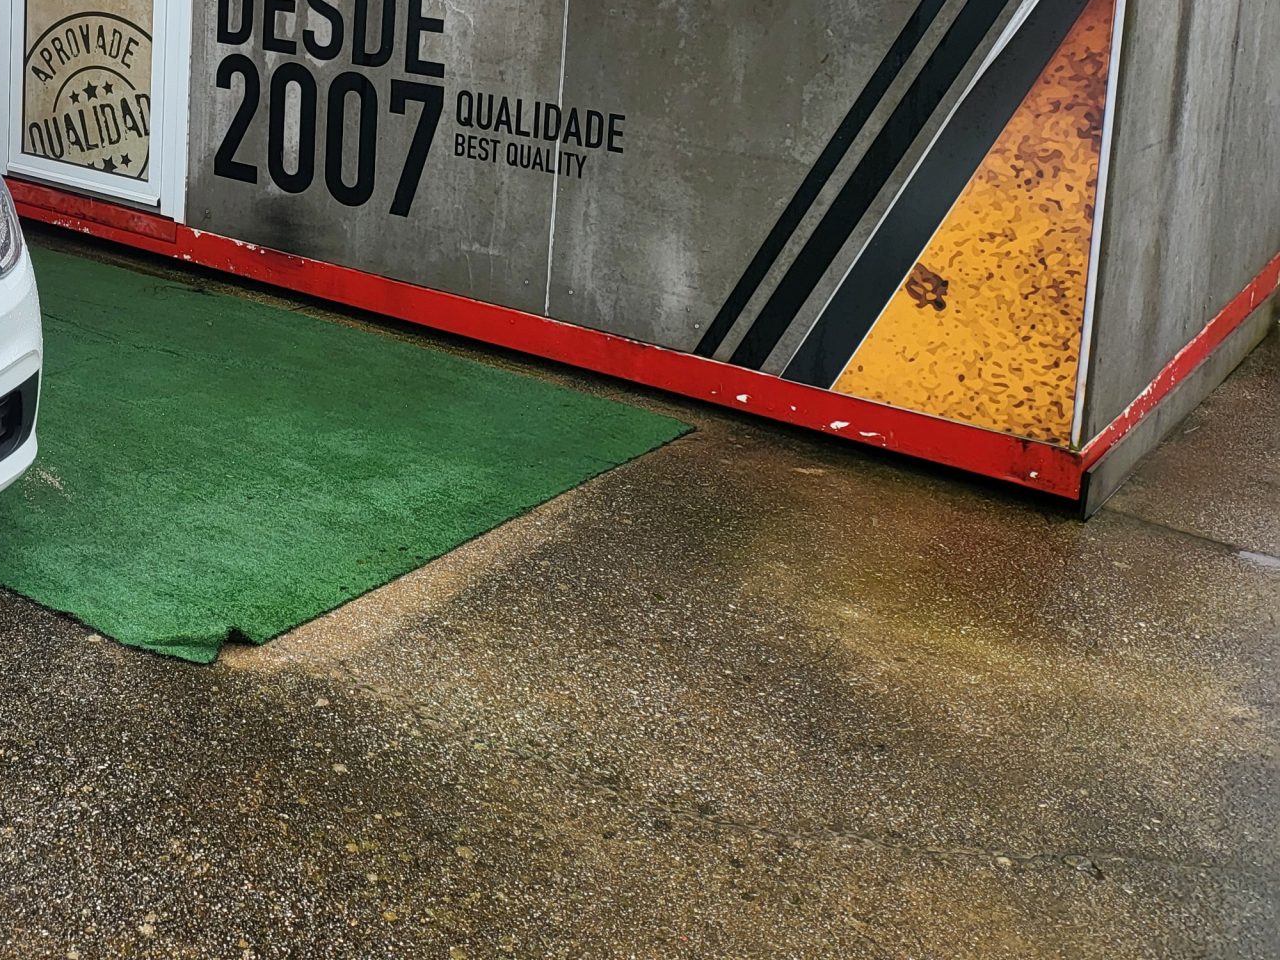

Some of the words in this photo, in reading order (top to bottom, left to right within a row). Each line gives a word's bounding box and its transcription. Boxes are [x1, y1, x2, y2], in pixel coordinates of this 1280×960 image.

[31, 24, 140, 83] APROVADE
[214, 53, 444, 218] 2007
[456, 90, 626, 154] QUALIDADE
[454, 133, 501, 163] BEST
[506, 142, 587, 179] QUALITY
